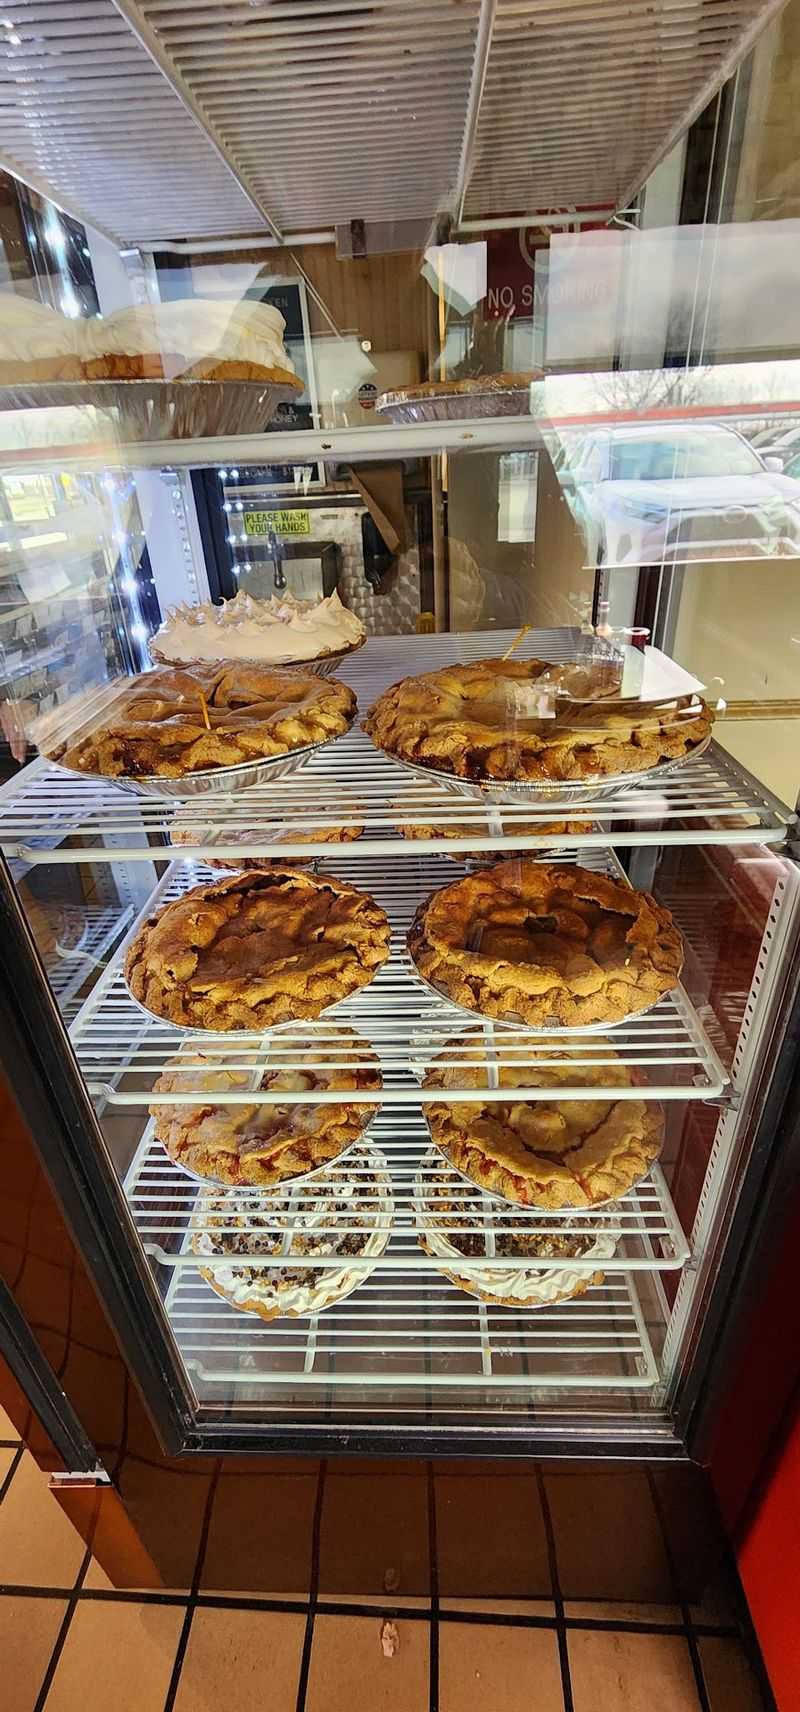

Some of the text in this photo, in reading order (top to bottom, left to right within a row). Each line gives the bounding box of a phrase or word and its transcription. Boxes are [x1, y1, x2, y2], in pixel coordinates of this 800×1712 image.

[488, 286, 514, 309] NO
[246, 511, 306, 523] PLEASE WASH
[249, 521, 306, 533] YOUR HANDS
